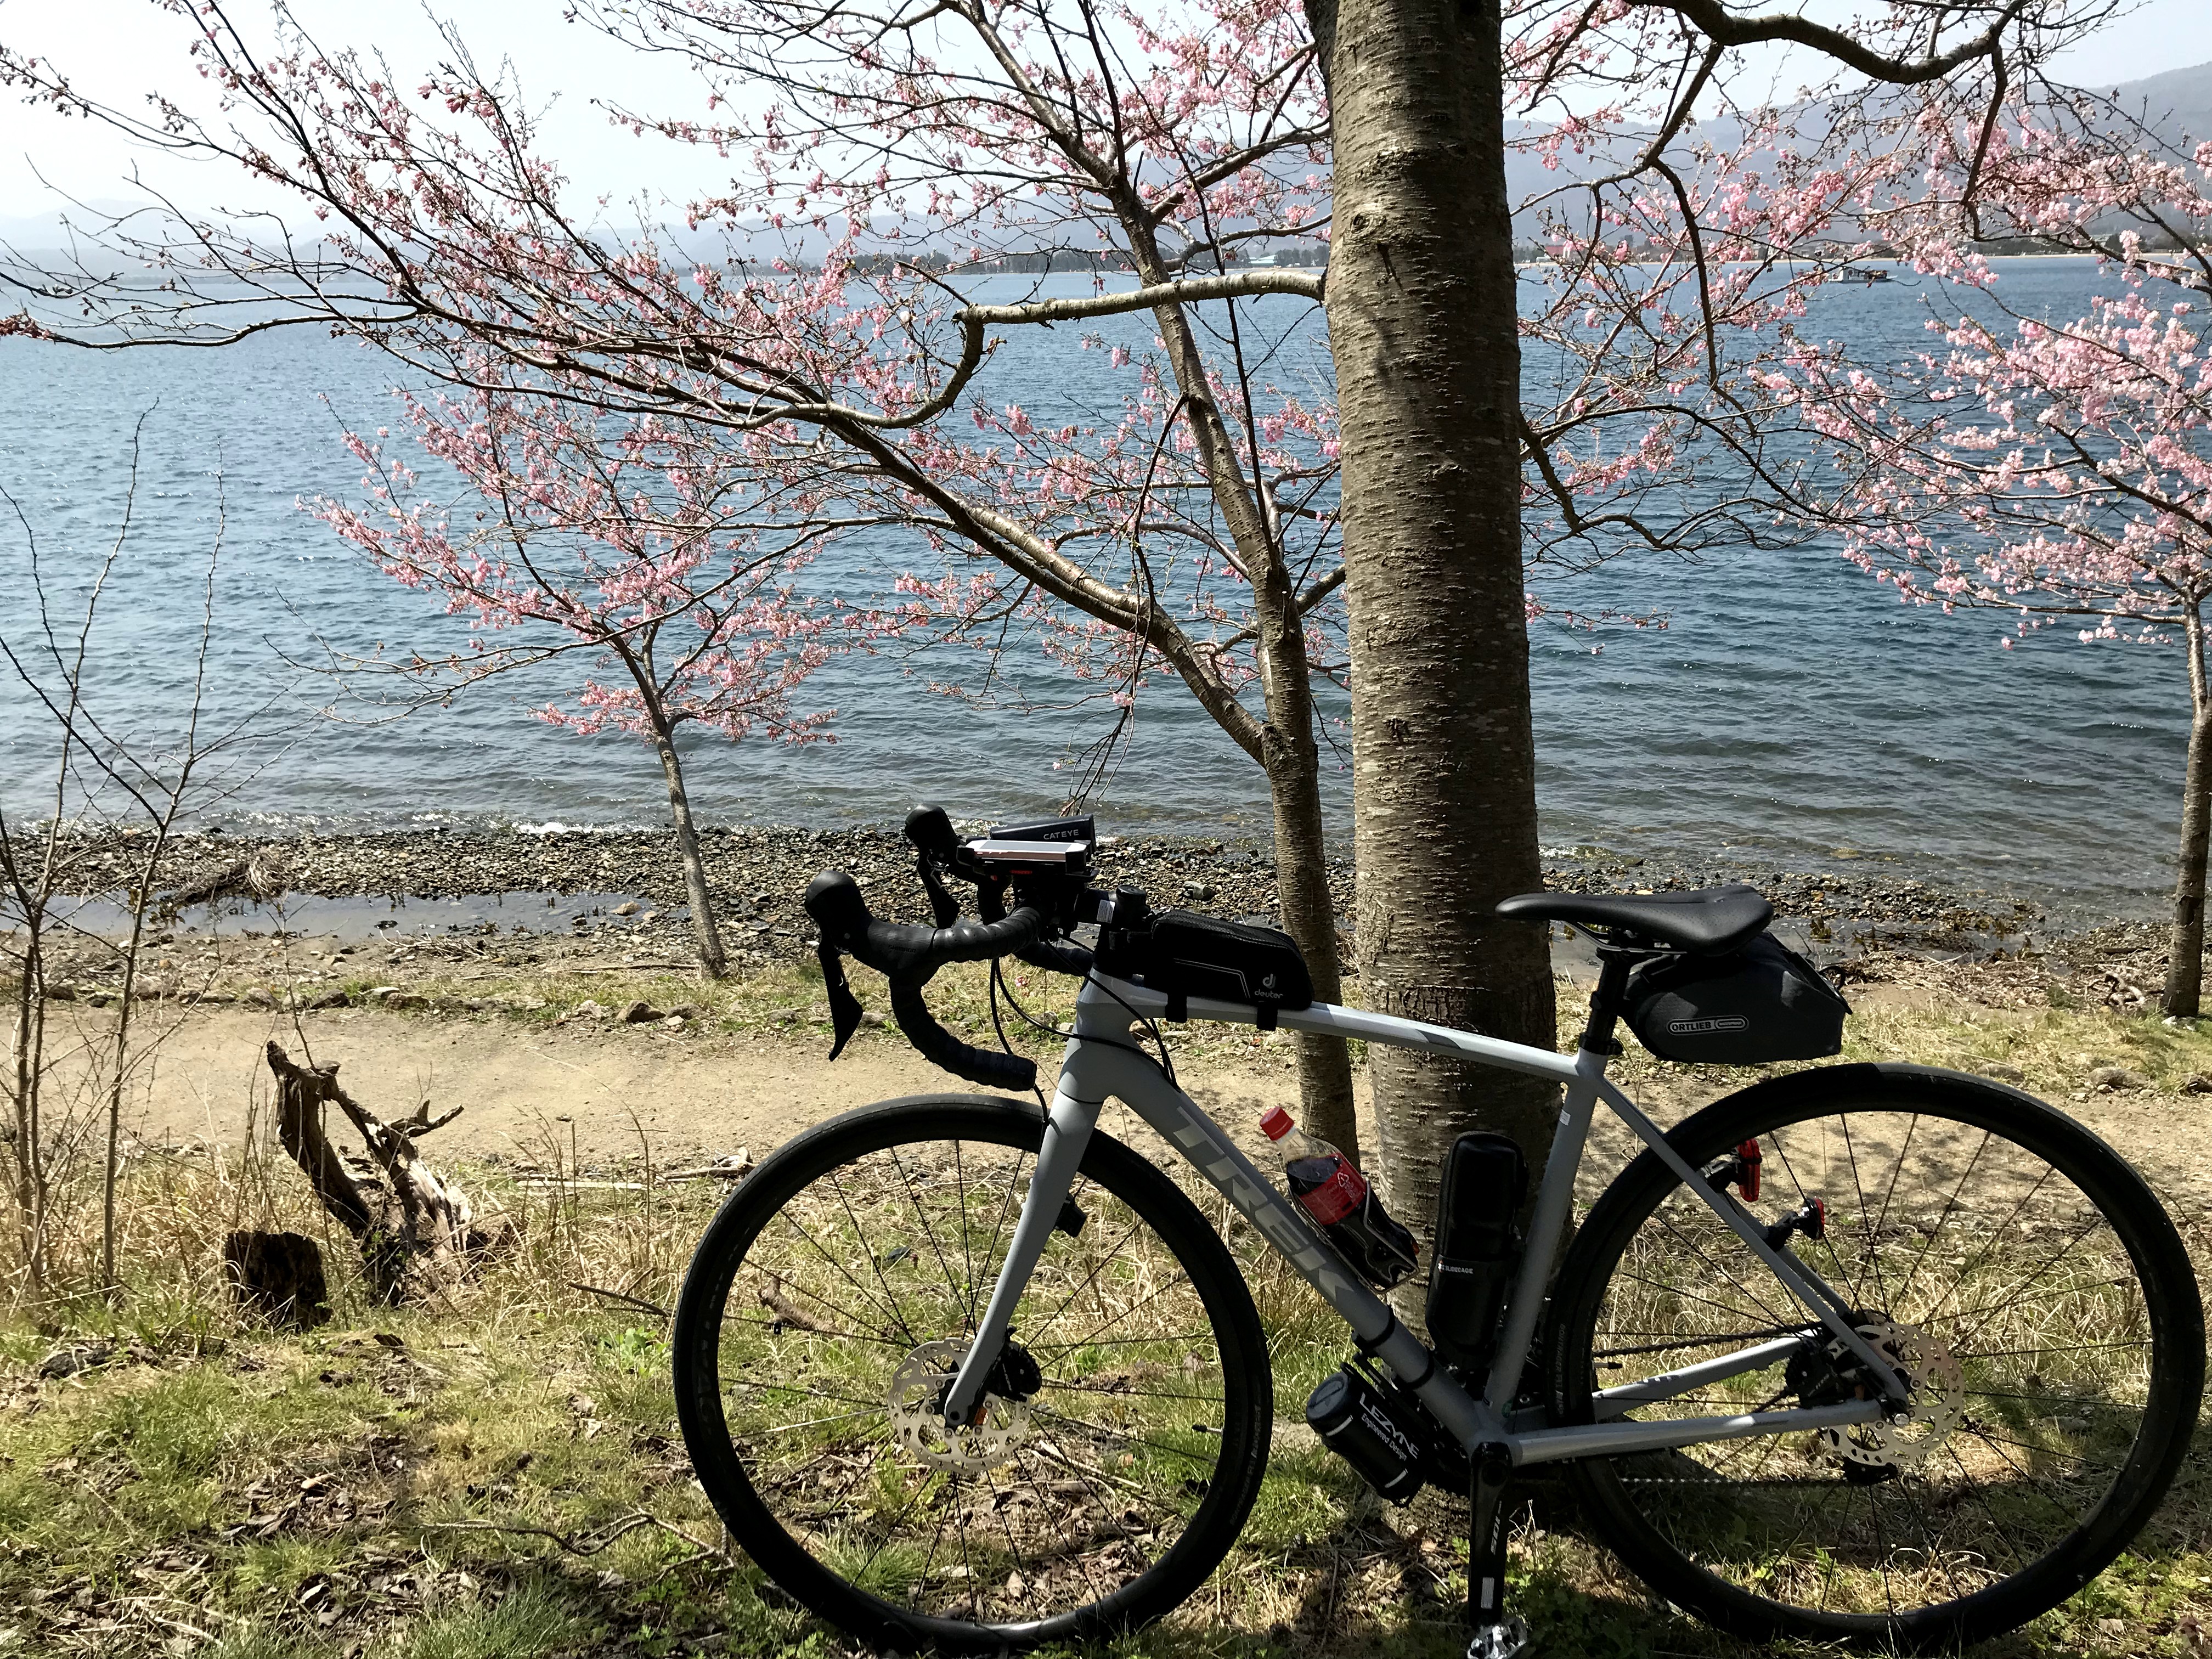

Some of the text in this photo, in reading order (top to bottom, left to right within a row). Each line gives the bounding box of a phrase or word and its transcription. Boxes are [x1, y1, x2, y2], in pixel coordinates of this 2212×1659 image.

[1043, 829, 1079, 840] CATEYE
[1254, 989, 1284, 998] deuter
[1672, 1022, 1712, 1031] ORTLIEB
[1173, 1106, 1354, 1301] TREK
[1359, 1392, 1419, 1459] LEZYNE
[1361, 1413, 1407, 1462] Engineered Design
[1491, 1515, 1500, 1555] 105
